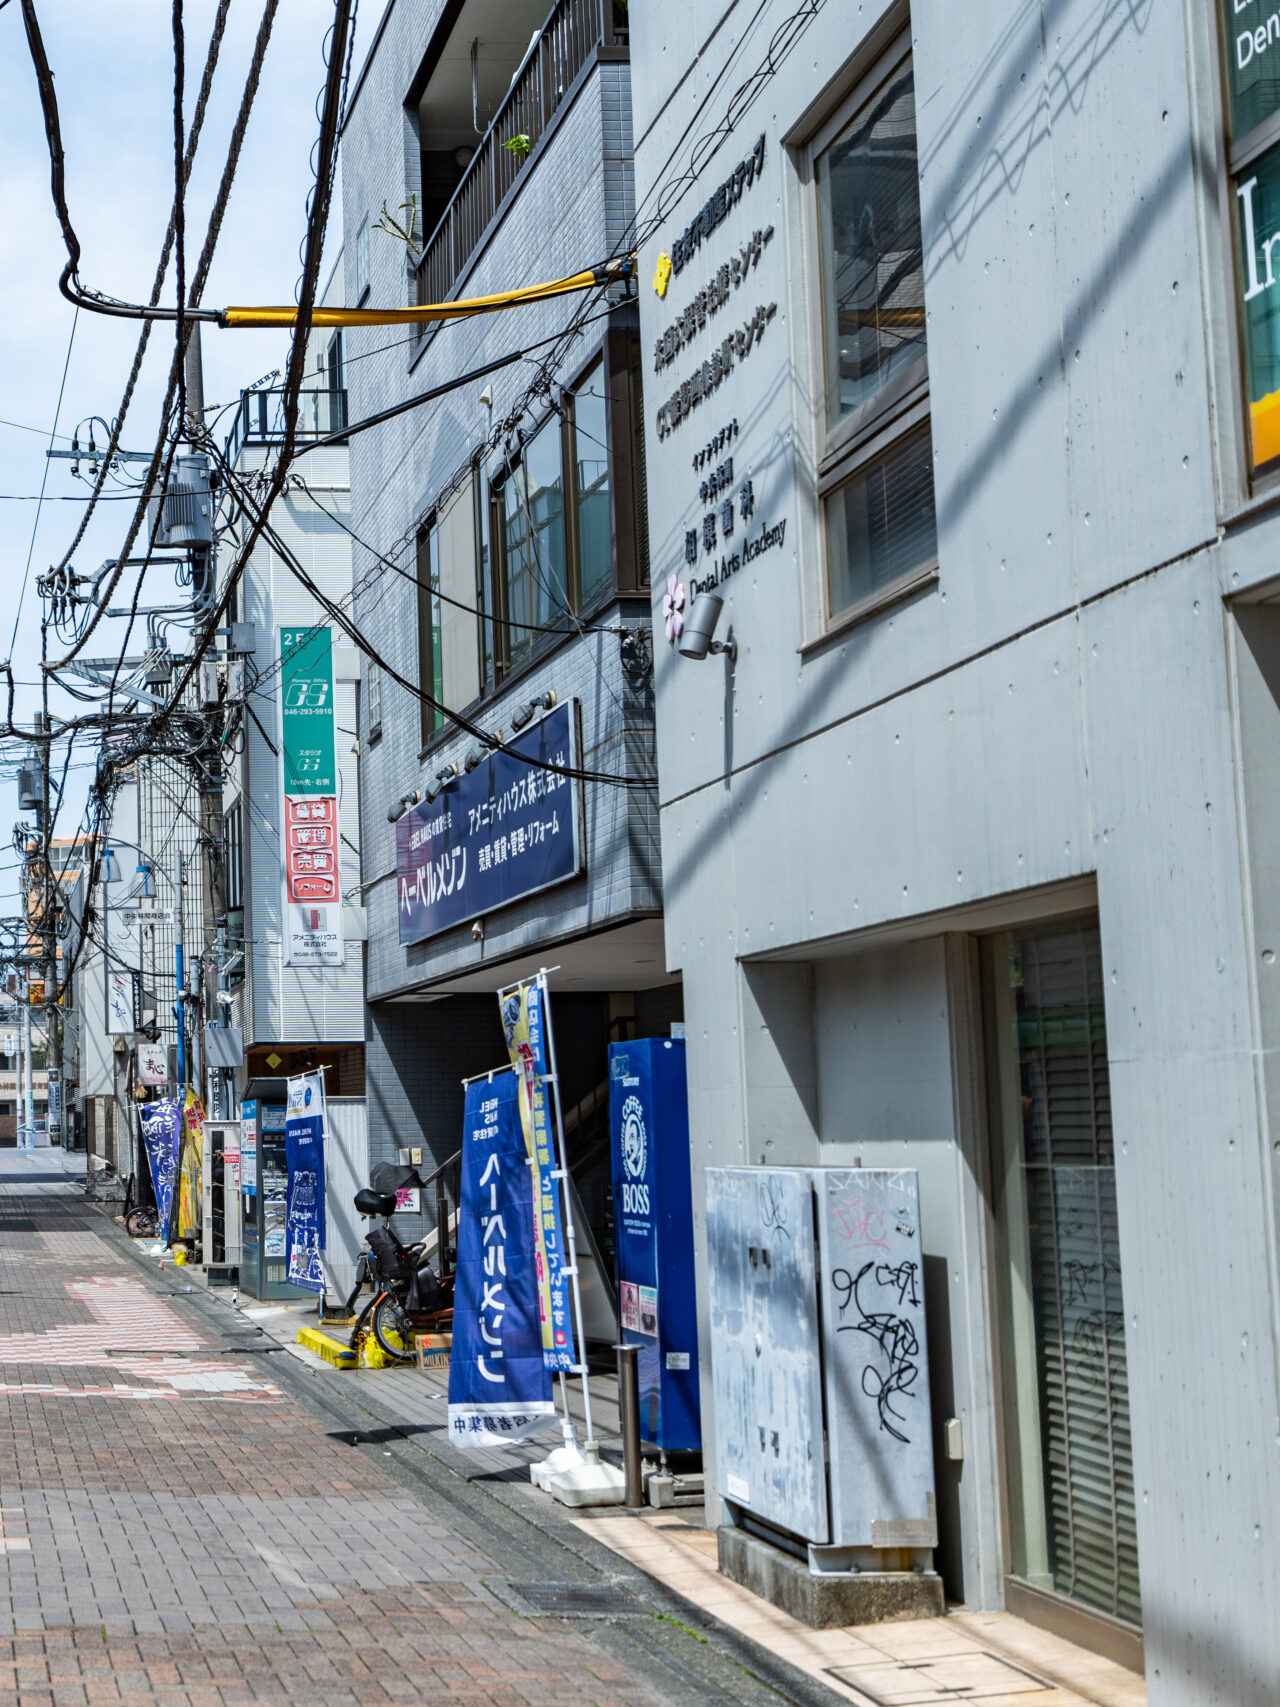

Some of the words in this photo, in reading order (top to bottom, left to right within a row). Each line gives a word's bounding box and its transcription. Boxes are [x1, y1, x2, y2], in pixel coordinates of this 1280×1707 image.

[690, 560, 718, 606] Dental
[721, 555, 741, 583] Arts
[742, 517, 787, 566] Academy
[284, 707, 333, 716] 046-293-5910
[297, 749, 323, 757] スタジオ
[400, 846, 468, 917] ヘーベルメゾン
[622, 1095, 644, 1121] COFFEE
[622, 1183, 651, 1216] BOSS
